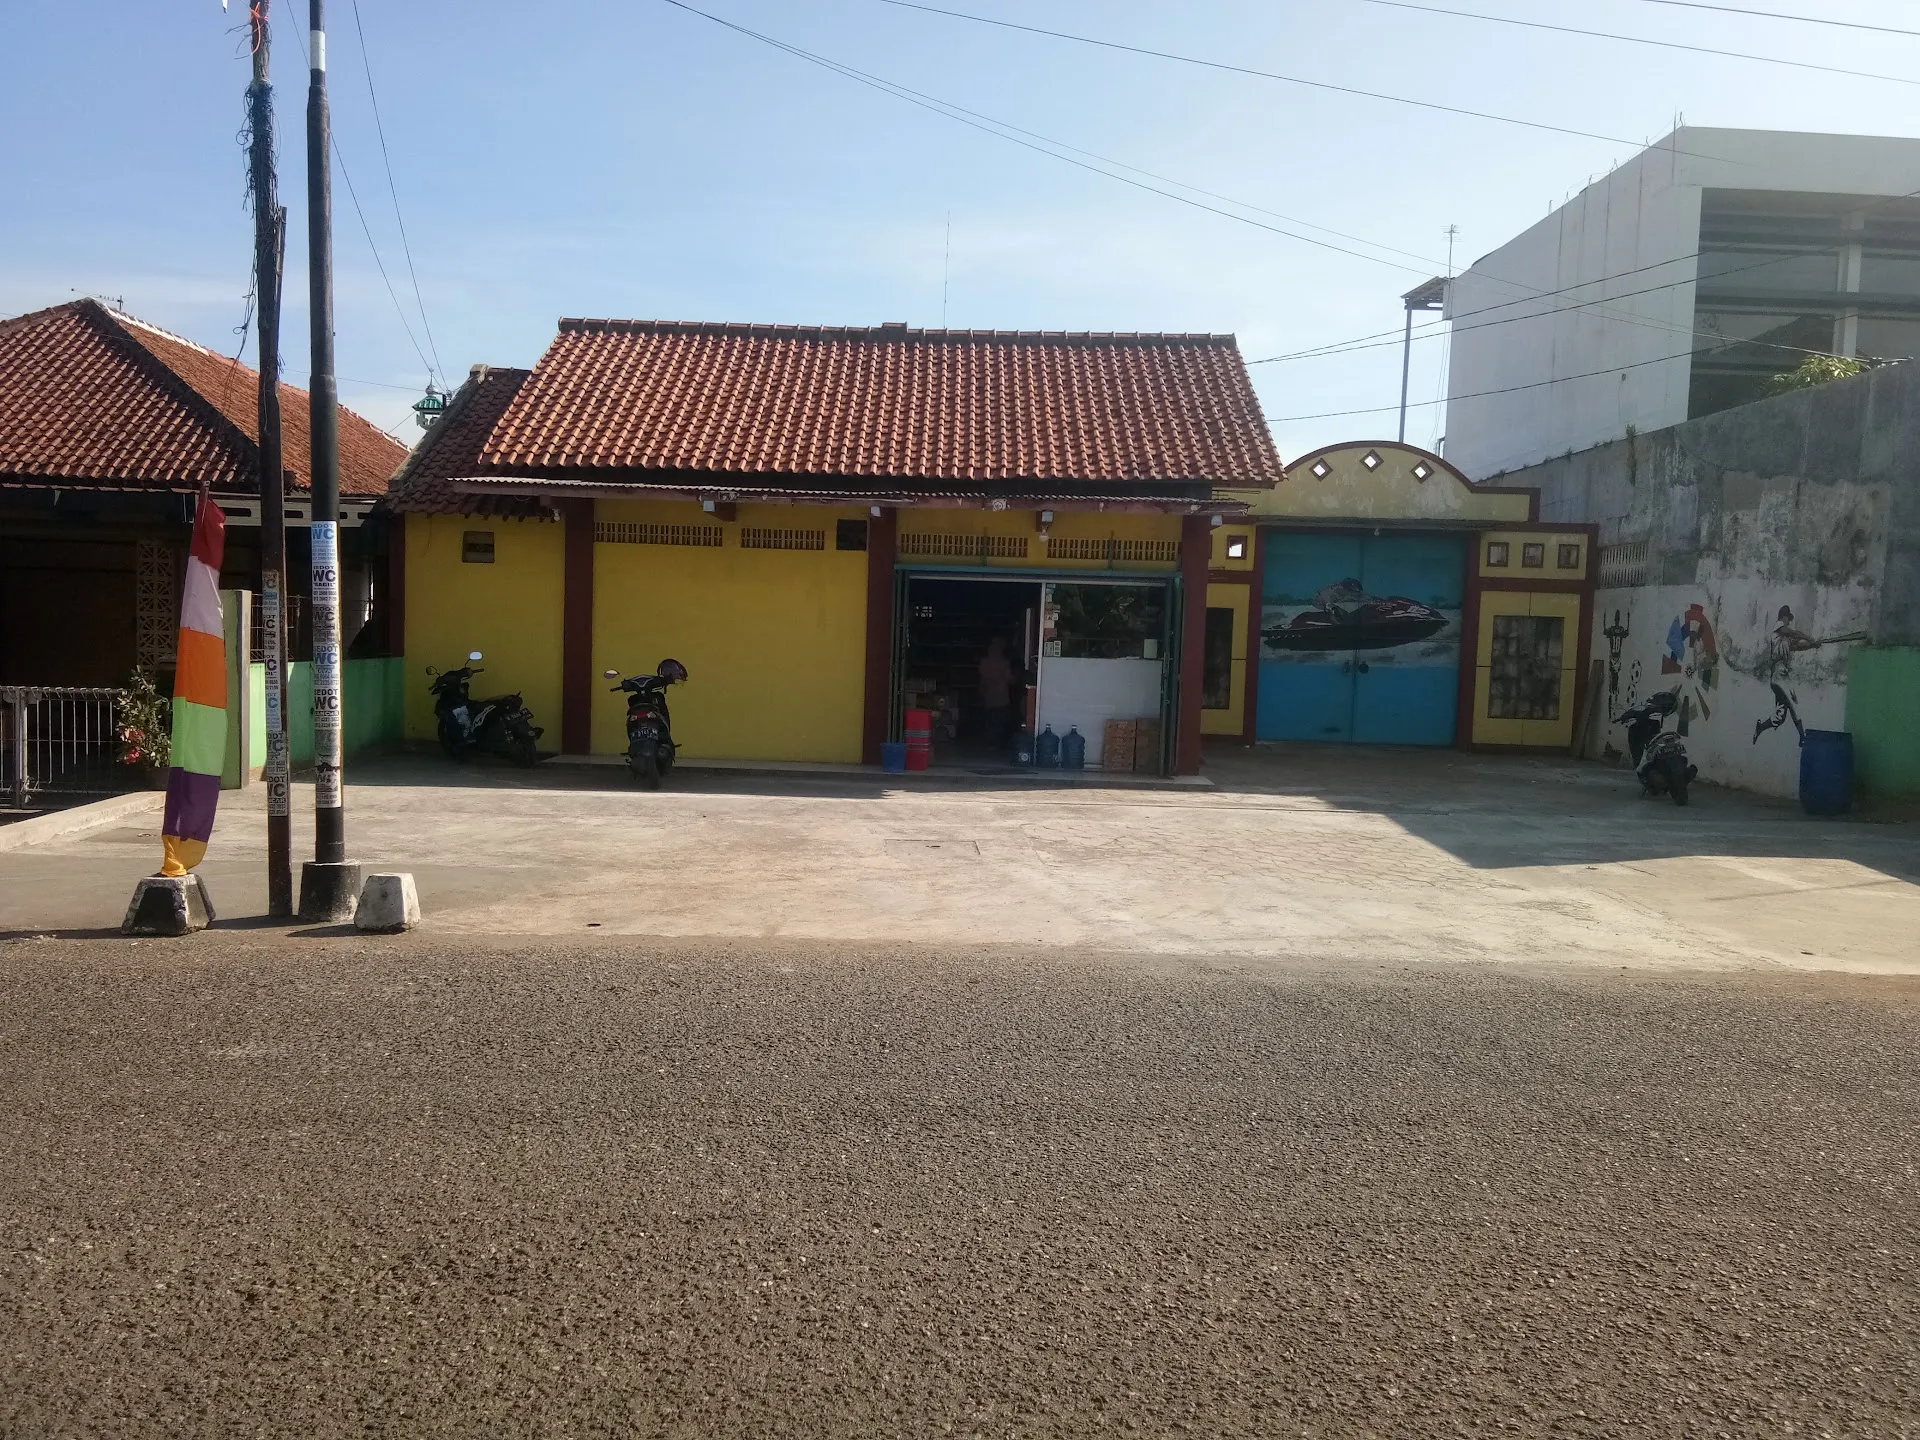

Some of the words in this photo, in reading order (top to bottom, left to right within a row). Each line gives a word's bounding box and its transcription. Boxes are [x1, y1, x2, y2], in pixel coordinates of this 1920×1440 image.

[312, 529, 335, 539] WC
[313, 570, 336, 582] WC
[315, 653, 338, 664] WC
[315, 696, 338, 709] WC
